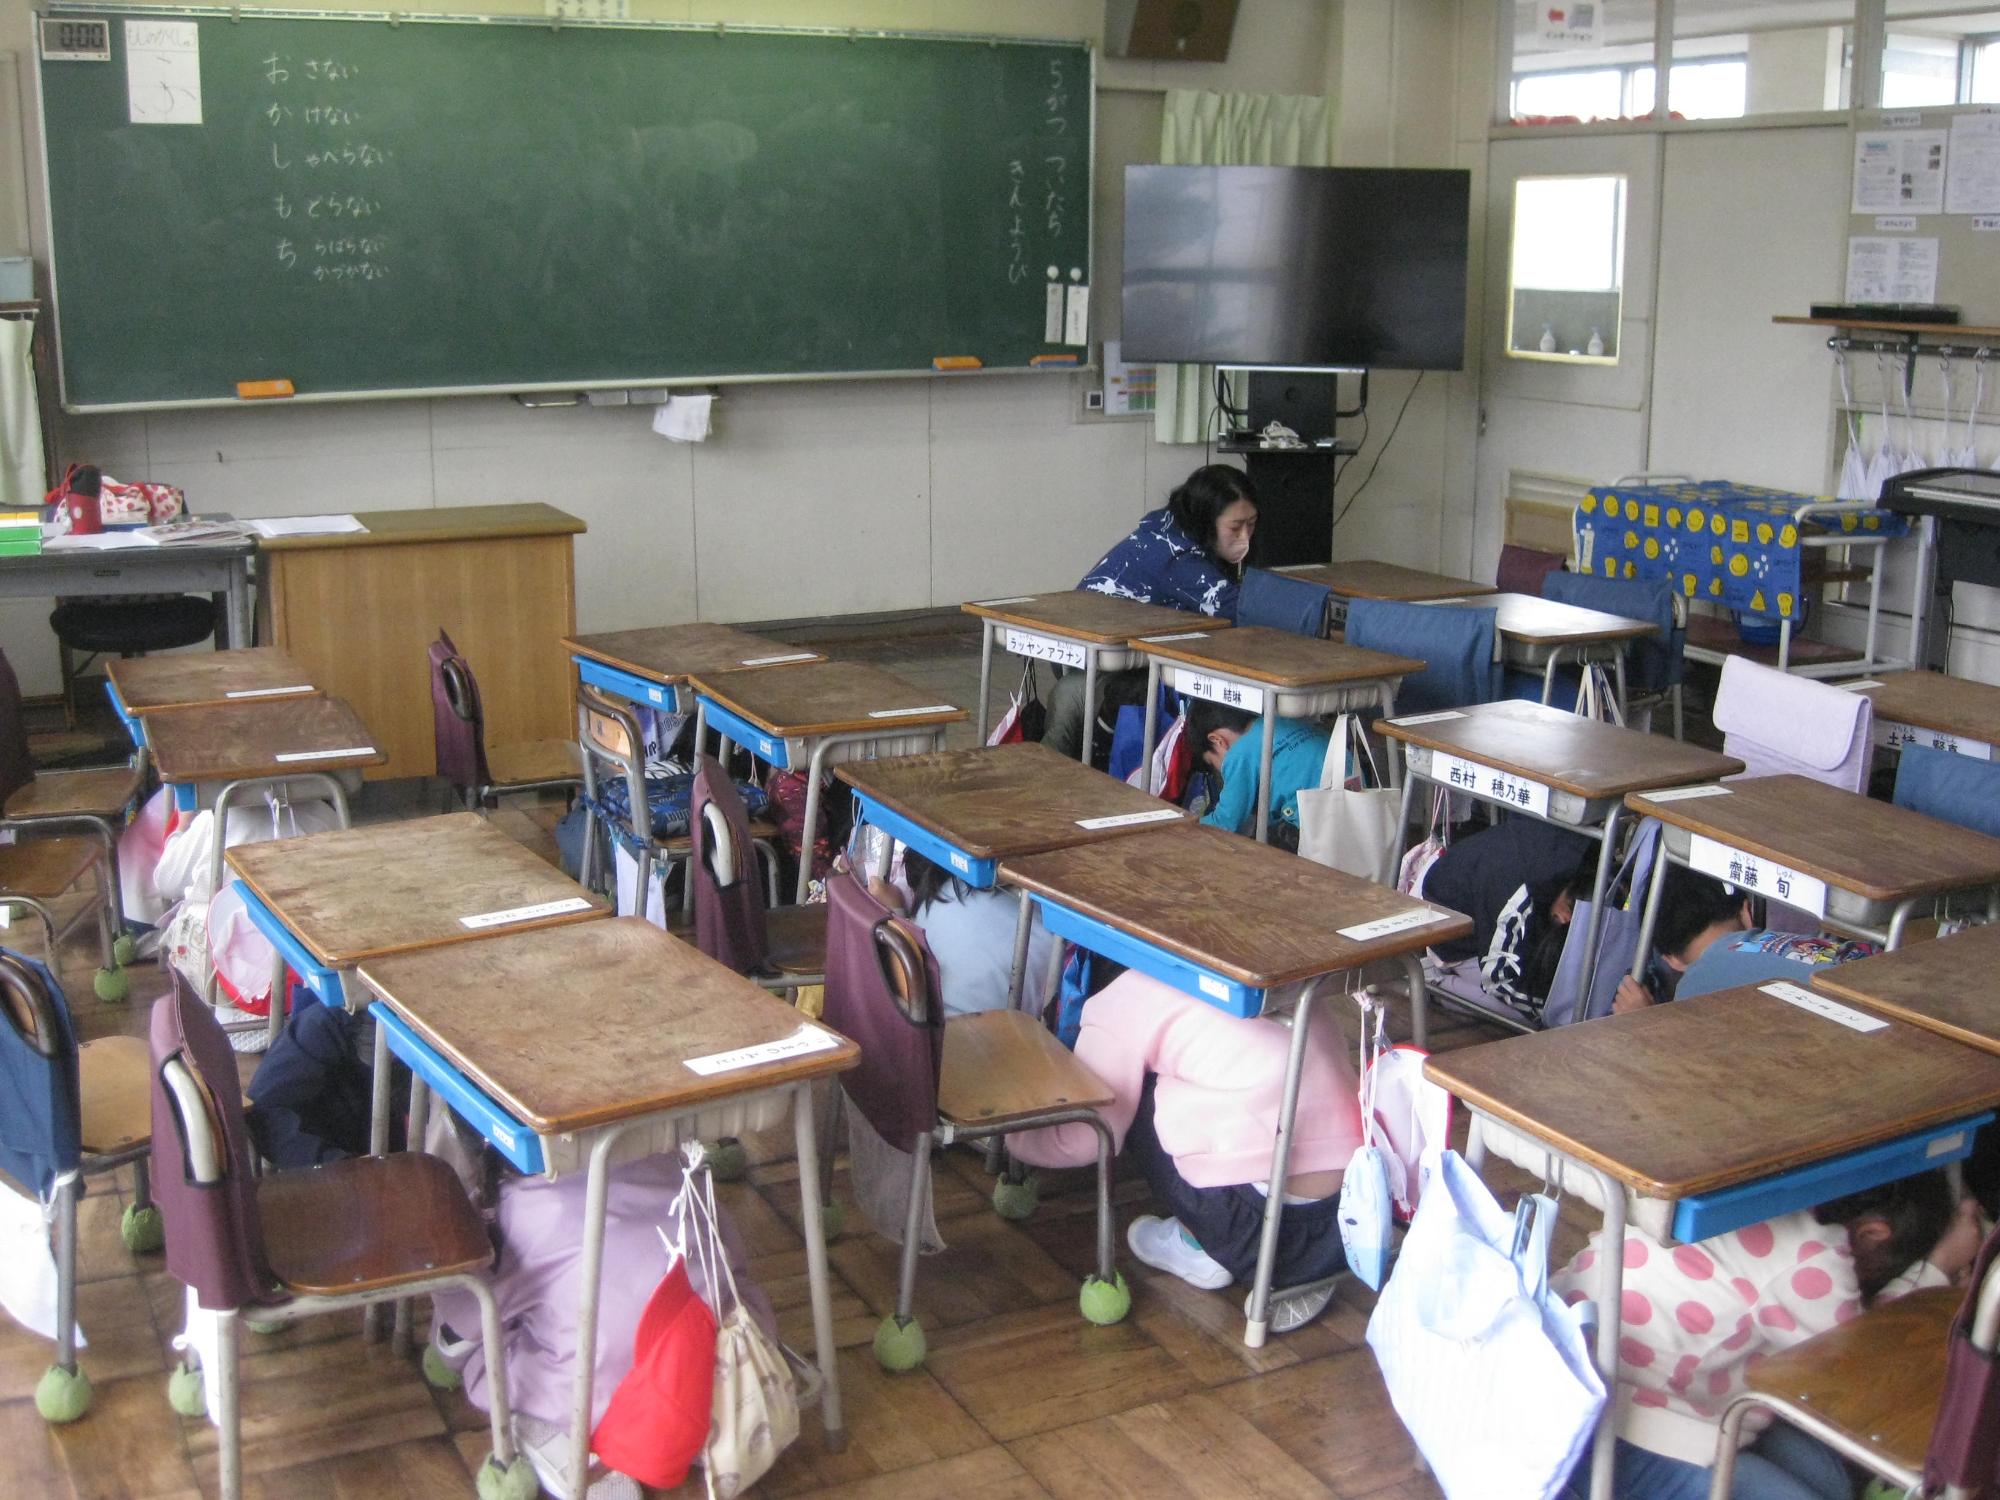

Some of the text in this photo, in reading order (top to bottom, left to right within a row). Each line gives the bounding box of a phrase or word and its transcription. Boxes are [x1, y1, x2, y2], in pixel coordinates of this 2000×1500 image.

[1193, 680, 1213, 699] 中川
[1450, 767, 1531, 806] 西村 穂乃華
[1776, 876, 1791, 899] 旬
